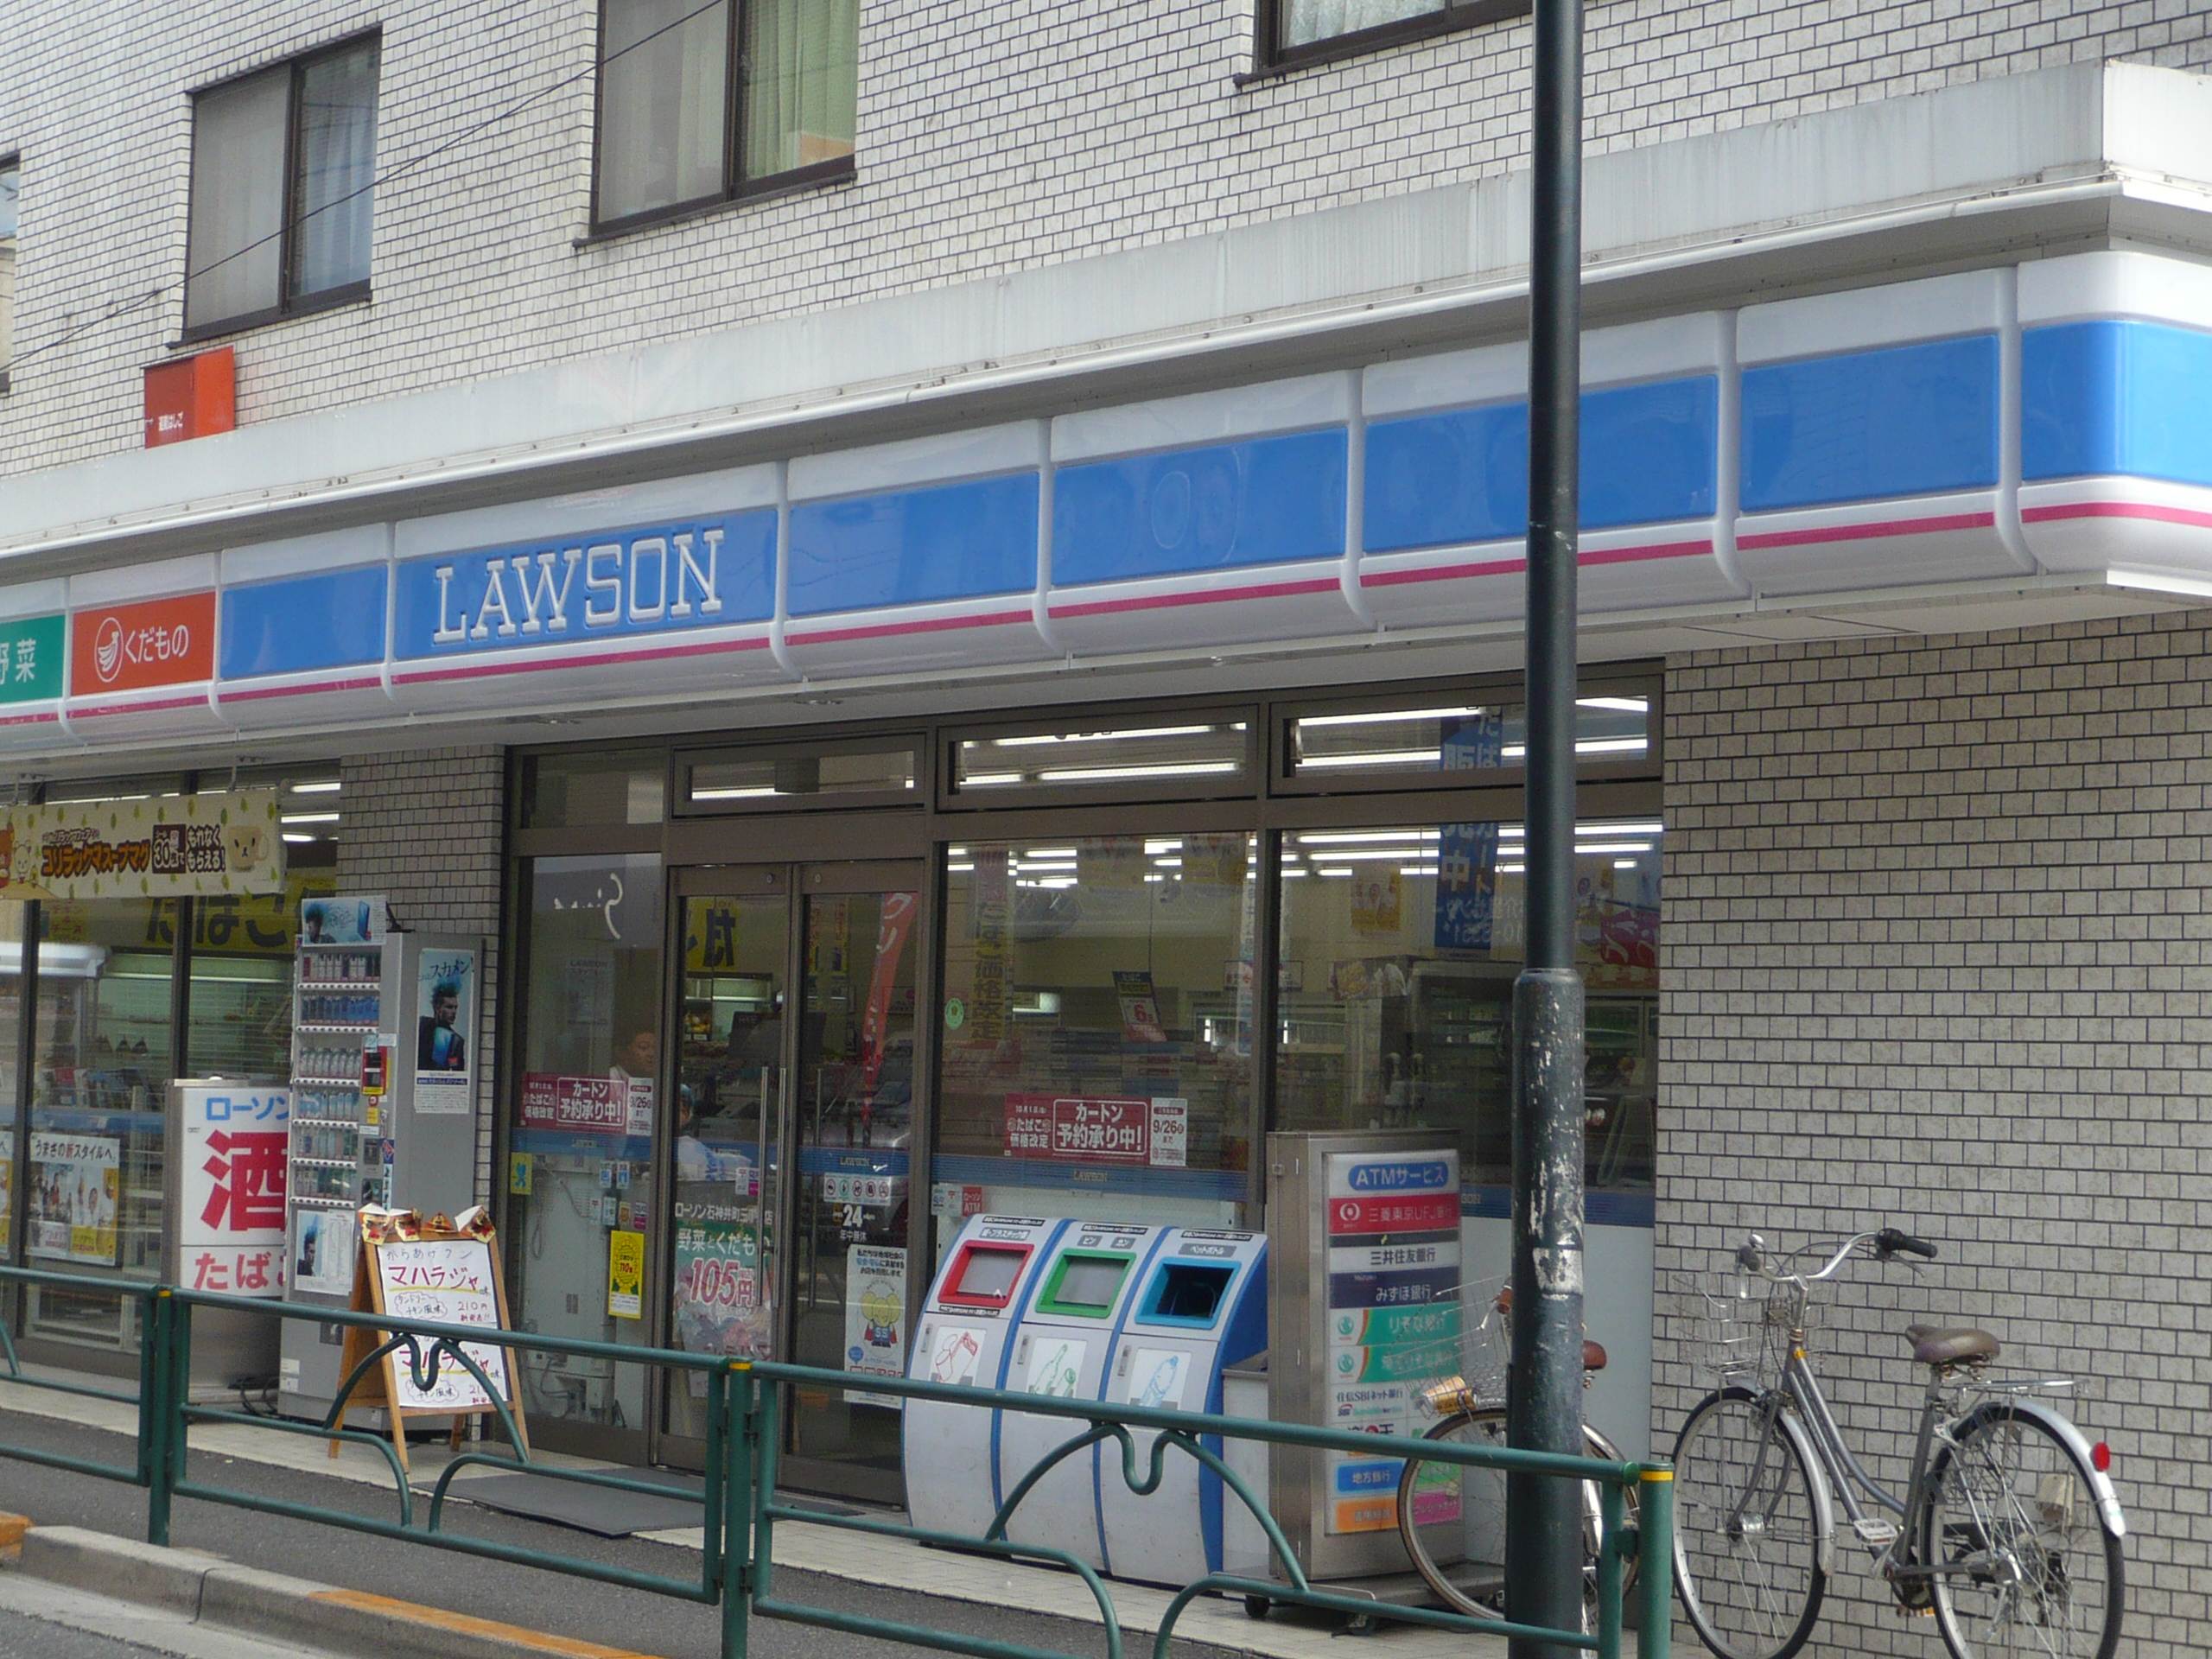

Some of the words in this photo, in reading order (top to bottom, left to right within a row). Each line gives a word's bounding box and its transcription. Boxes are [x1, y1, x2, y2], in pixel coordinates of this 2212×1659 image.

[433, 529, 724, 644] LAWSON
[125, 625, 189, 664] くだもの
[573, 1082, 608, 1098] カートン
[206, 1096, 289, 1121] ローソン
[561, 1098, 621, 1122] 予約承り中!
[1076, 1103, 1123, 1123] カートン
[1057, 1122, 1142, 1151] 予約承り中!
[200, 1128, 289, 1231] 酒
[1356, 1166, 1445, 1186] ATMサービス
[842, 1205, 862, 1227] 24
[1370, 1247, 1436, 1266] 三井住友銀行
[194, 1252, 284, 1291] たば
[1376, 1284, 1432, 1302] みずほ銀行
